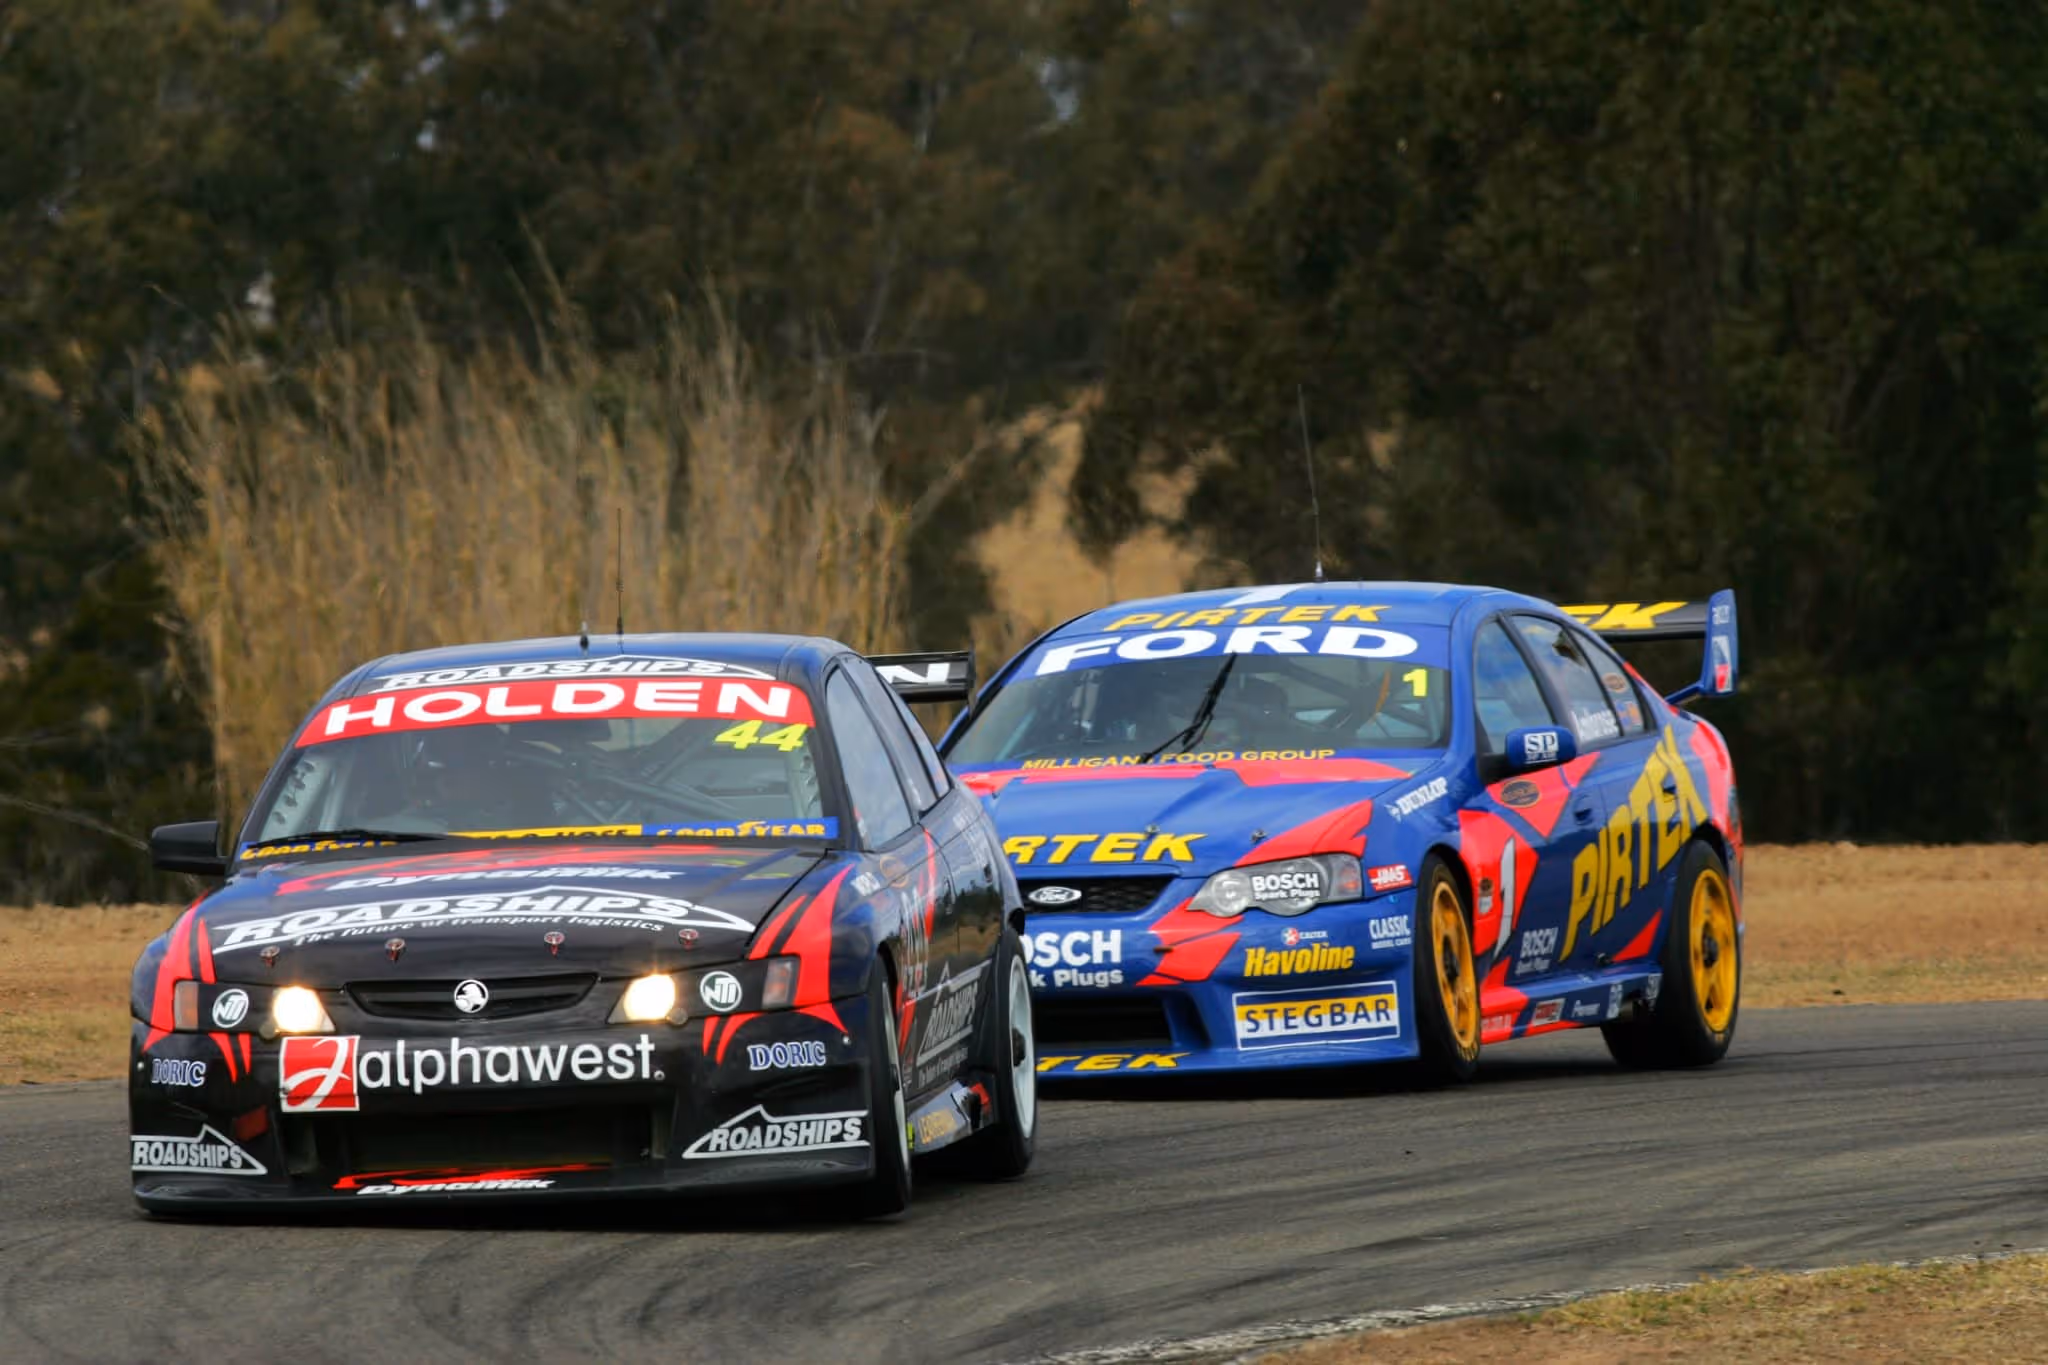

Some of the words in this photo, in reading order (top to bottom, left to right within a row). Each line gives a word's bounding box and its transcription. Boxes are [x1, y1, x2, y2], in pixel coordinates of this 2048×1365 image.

[1104, 604, 1392, 632] PIRTEK
[1035, 625, 1418, 676] FORD
[383, 660, 728, 690] ROADSHIPS
[1403, 669, 1428, 698] 1
[324, 681, 791, 736] HOLDEN
[714, 719, 808, 752] 44
[1161, 751, 1234, 764] FOOD
[1240, 749, 1336, 762] GROUP
[1558, 722, 1709, 963] PIRTEK
[1252, 872, 1319, 892] BOSCH
[223, 895, 689, 946] ROADSHIPS
[293, 931, 335, 946] The
[340, 922, 414, 937] future
[450, 915, 563, 926] transport
[568, 916, 664, 932] logistics
[1369, 914, 1411, 941] CLASSIC
[1019, 929, 1121, 968] SCH
[1243, 942, 1356, 978] Havoline
[1053, 968, 1123, 988] Plugs
[1244, 998, 1392, 1033] STEGBAR
[358, 1034, 655, 1094] alphawest
[748, 1040, 827, 1071] DORIC
[151, 1058, 207, 1087] DORIC
[707, 1117, 863, 1153] ROADSHIPS
[133, 1140, 244, 1169] ROADSHIPS
